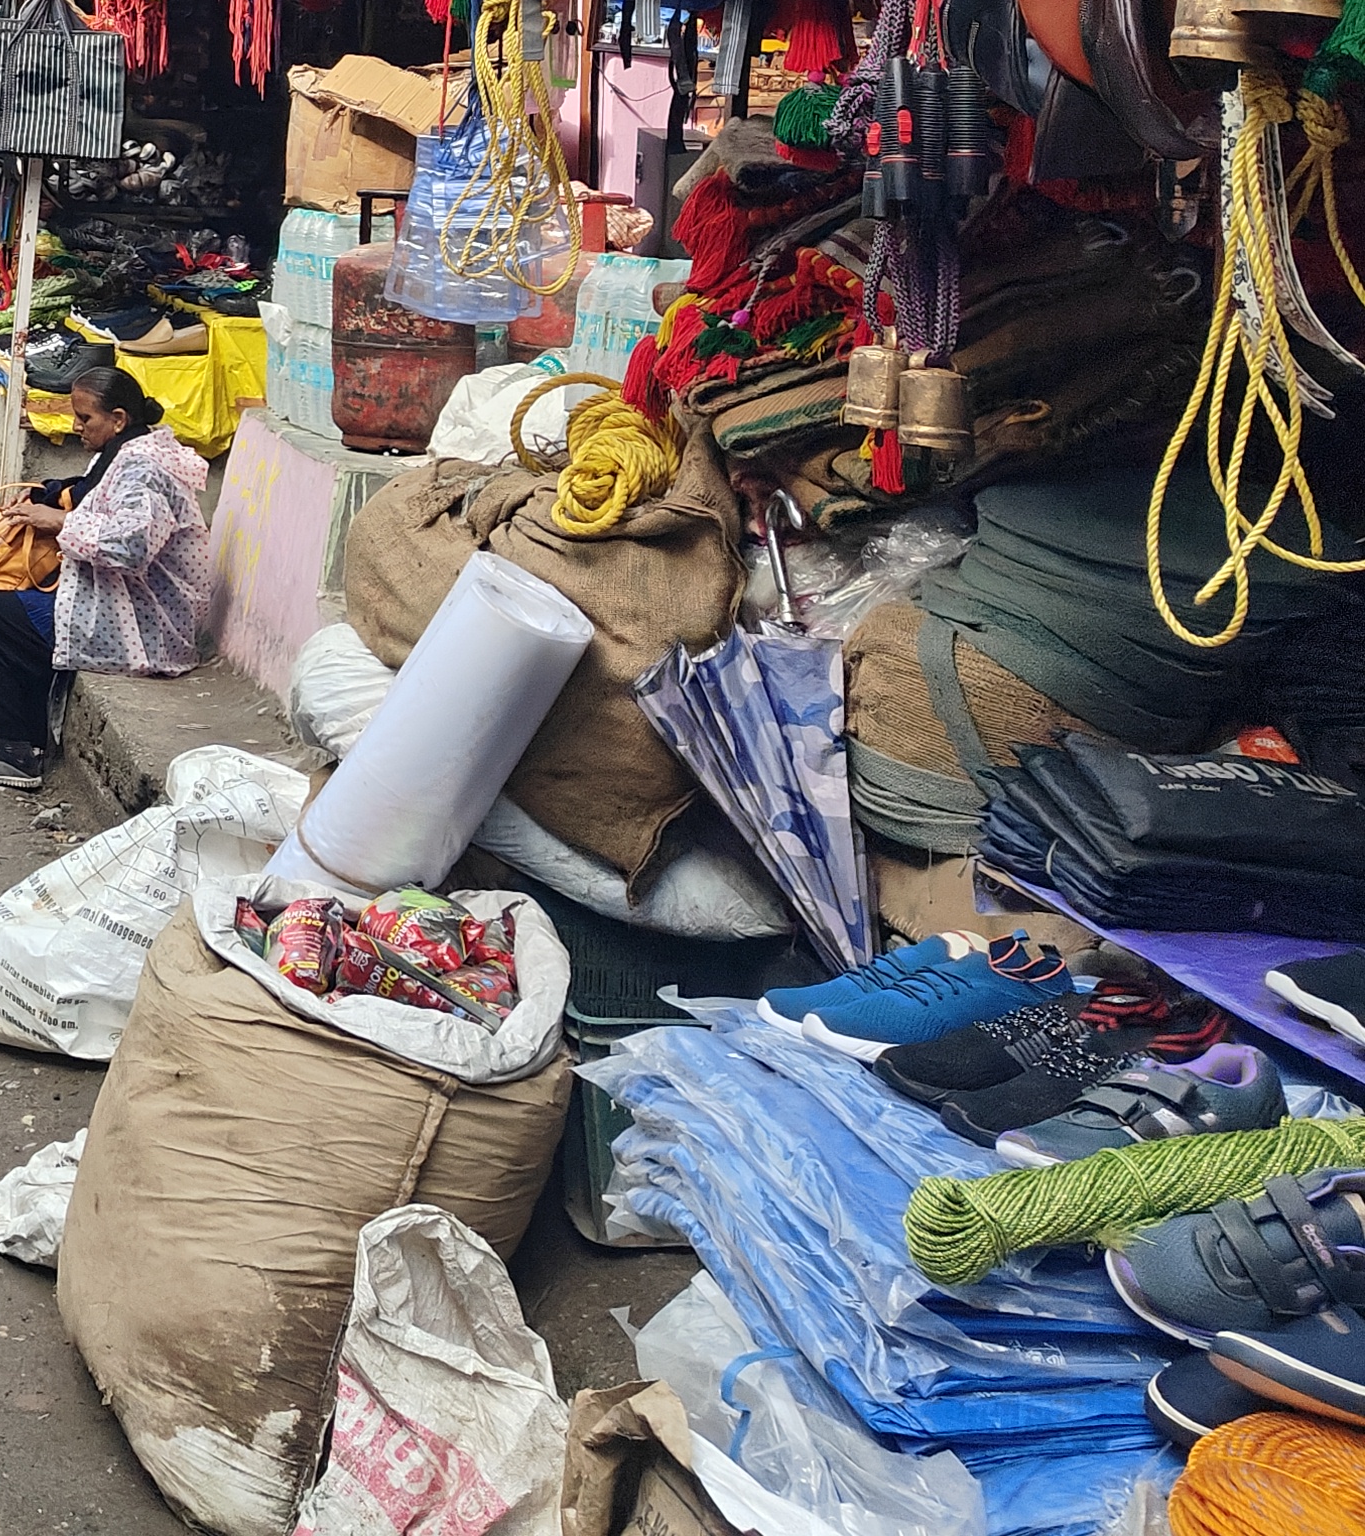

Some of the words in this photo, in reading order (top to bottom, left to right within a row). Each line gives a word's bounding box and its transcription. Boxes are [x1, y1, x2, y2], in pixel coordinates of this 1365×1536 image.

[1127, 752, 1259, 783] TURBO
[1253, 762, 1358, 797] PLUS
[154, 861, 176, 879] 1.48
[143, 884, 167, 901] 1.60
